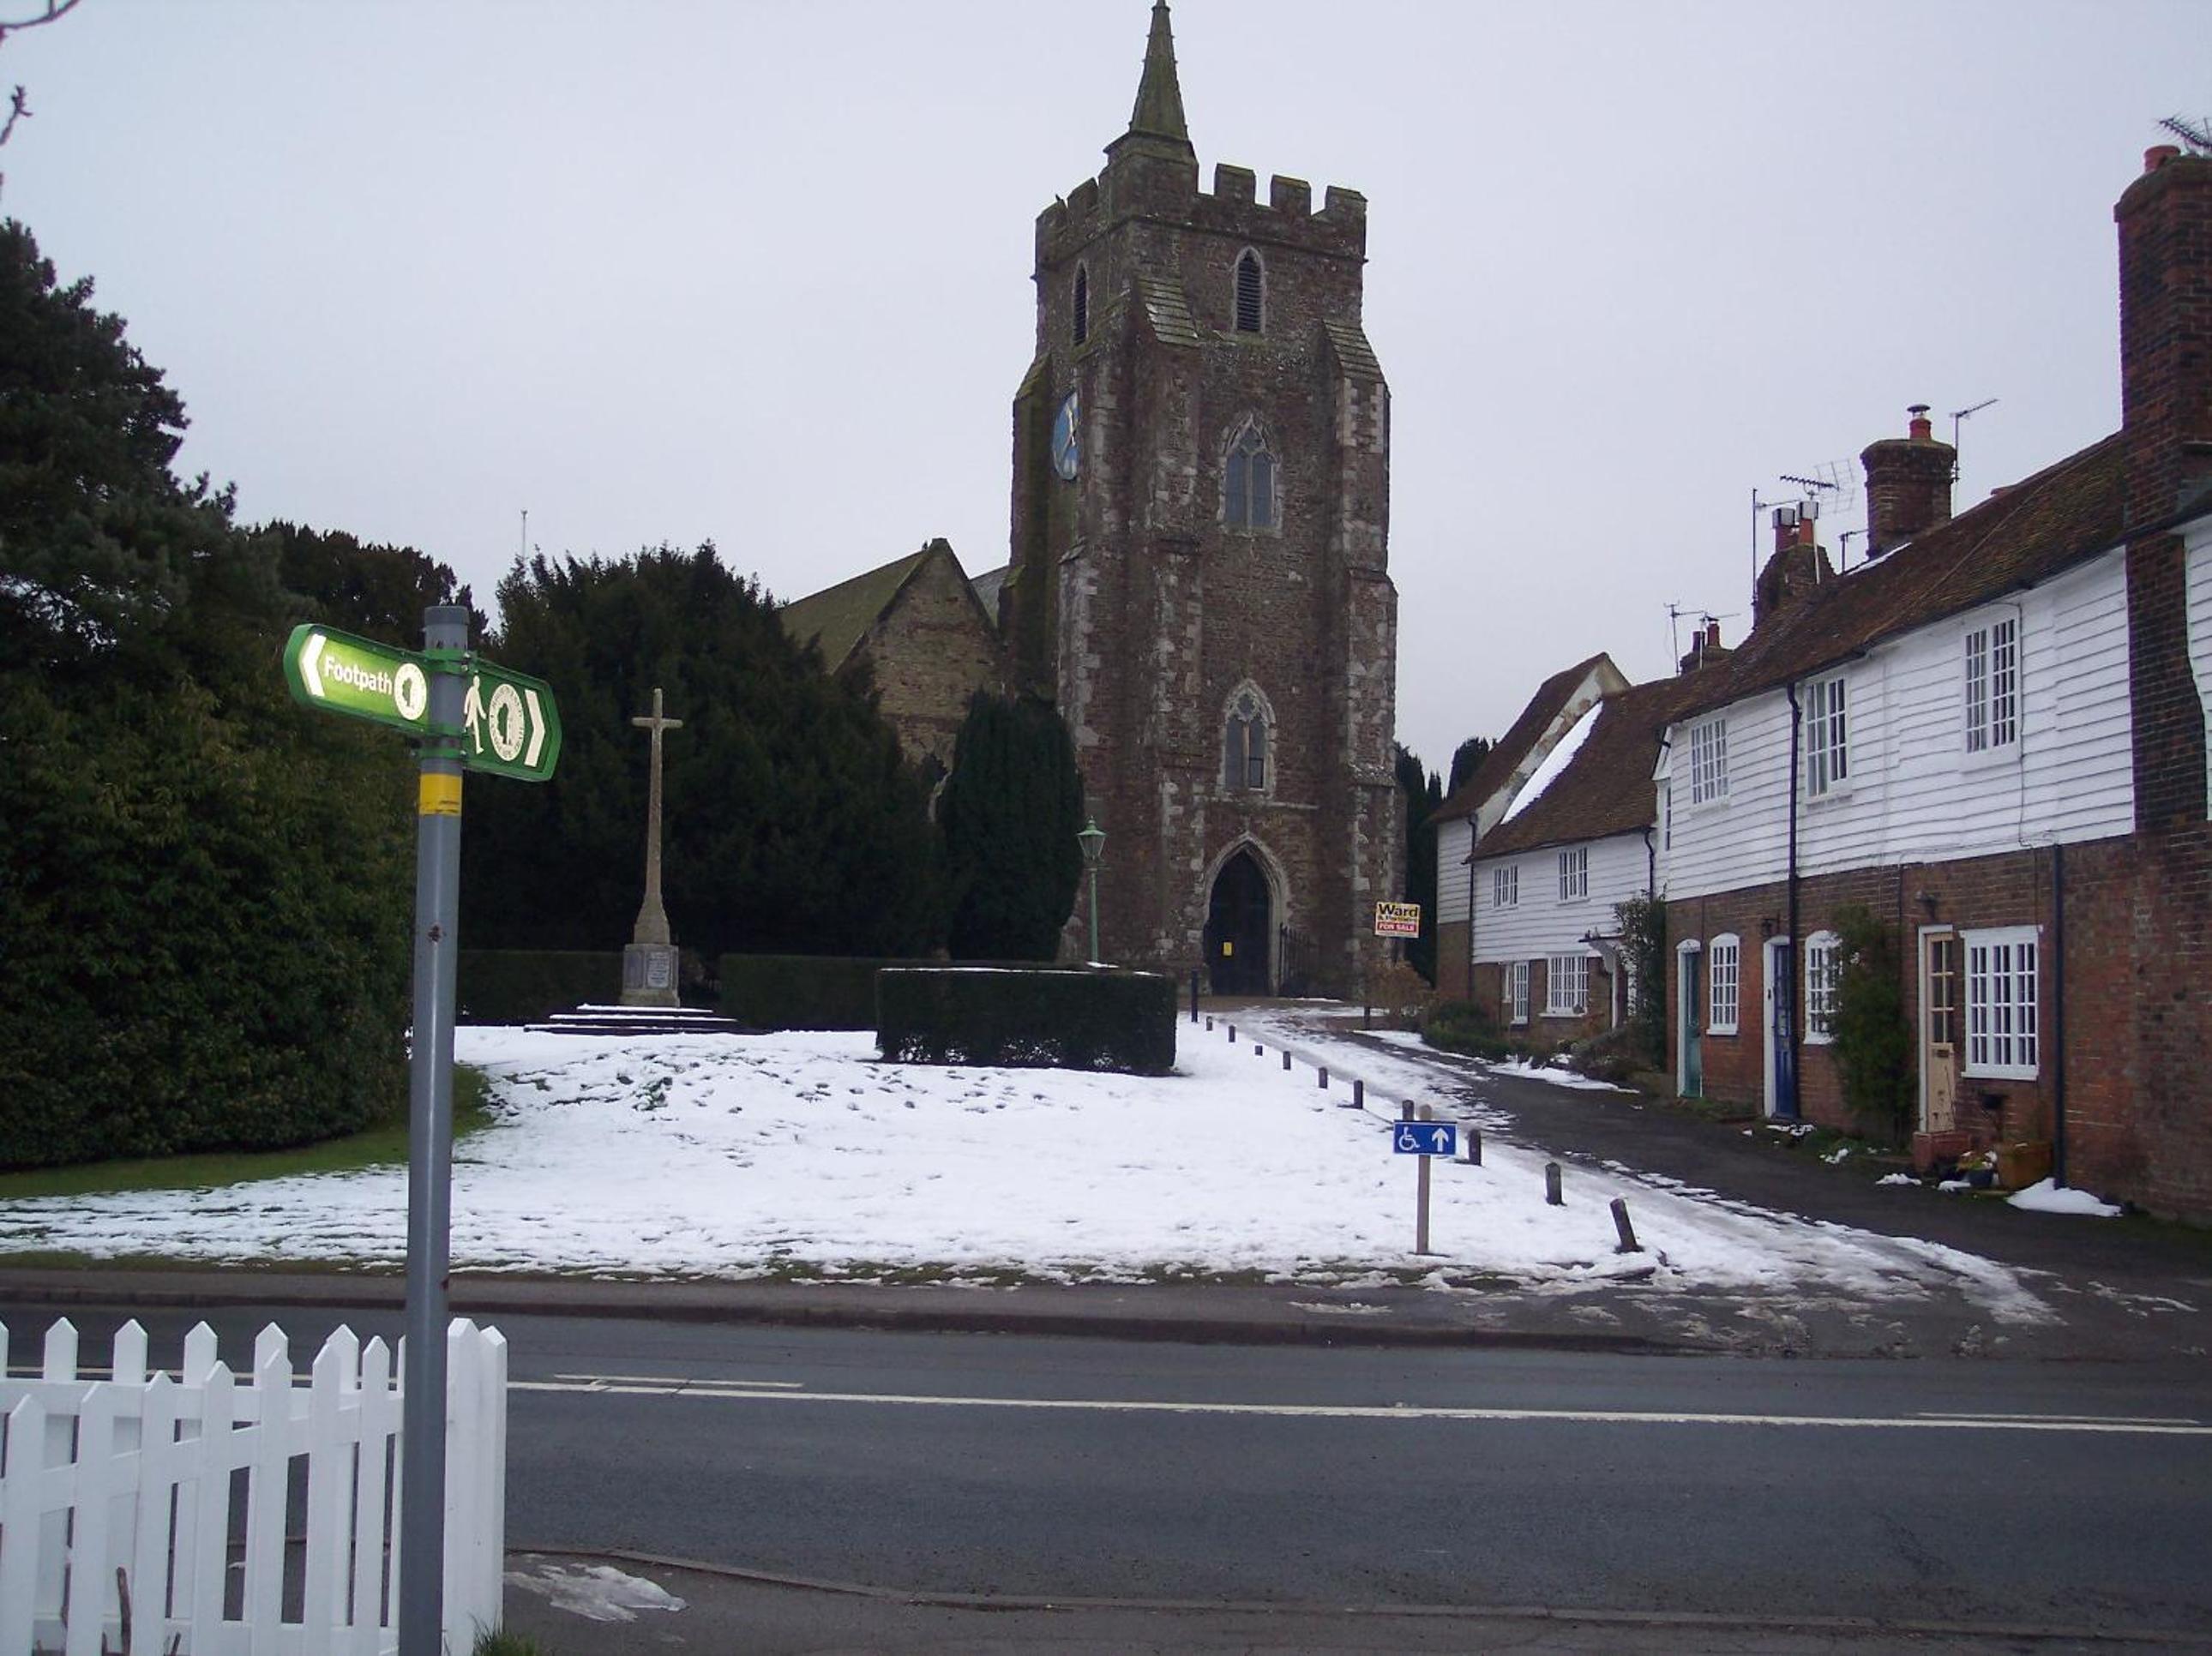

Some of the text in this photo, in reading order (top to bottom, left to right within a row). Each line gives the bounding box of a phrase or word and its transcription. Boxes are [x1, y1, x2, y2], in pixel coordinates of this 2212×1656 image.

[325, 656, 392, 694] Footpath
[1379, 903, 1418, 917] Ward
[1396, 923, 1414, 932] SALE
